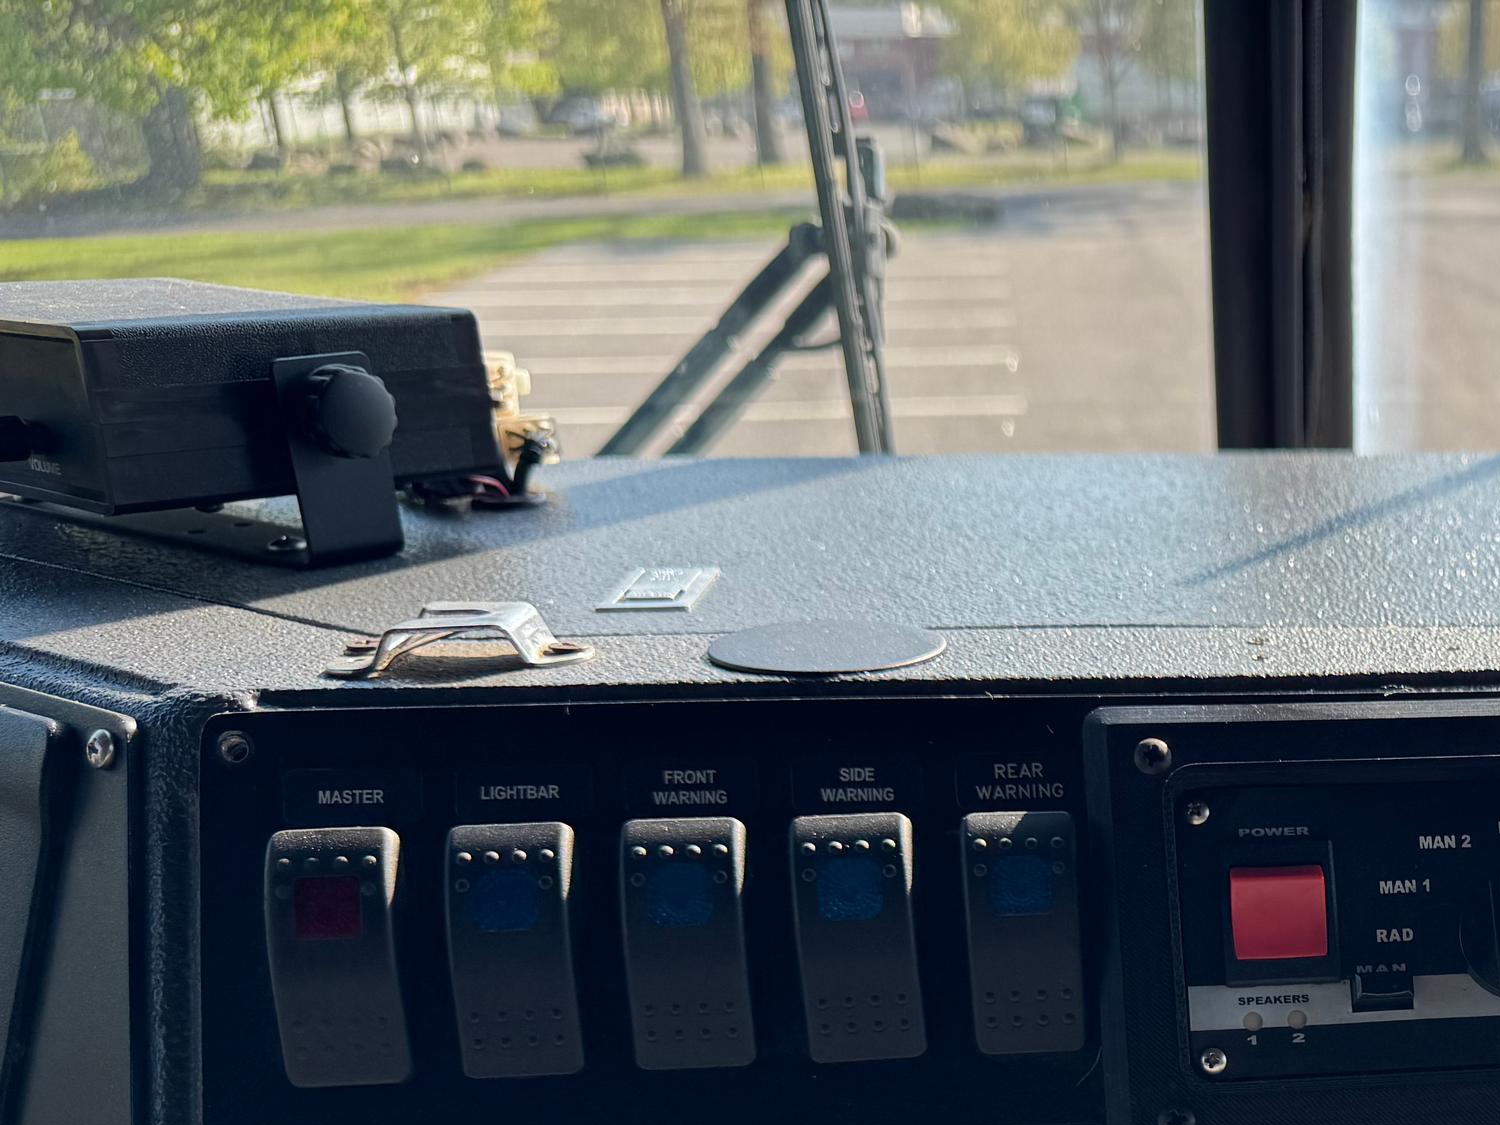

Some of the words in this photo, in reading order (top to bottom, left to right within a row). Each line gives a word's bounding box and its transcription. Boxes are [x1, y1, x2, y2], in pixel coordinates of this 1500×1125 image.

[664, 770, 716, 784] FRONT
[840, 768, 874, 781] SIDE
[994, 763, 1043, 778] REAR
[319, 790, 384, 804] MASTER
[481, 785, 559, 799] LIGHTBAR
[653, 790, 727, 804] WARNING
[821, 788, 894, 801] WARNING
[976, 783, 1063, 799] WARNING
[1239, 827, 1308, 837] POWER
[1419, 835, 1455, 849] MAN
[1462, 835, 1471, 847] 2
[1380, 880, 1416, 894] MAN
[1423, 879, 1429, 892] 1
[1377, 928, 1413, 942] RAD
[1355, 962, 1407, 975] MAN
[1239, 995, 1309, 1005] SPEAKERS
[1248, 1035, 1256, 1045] 1
[1293, 1033, 1305, 1043] 2
